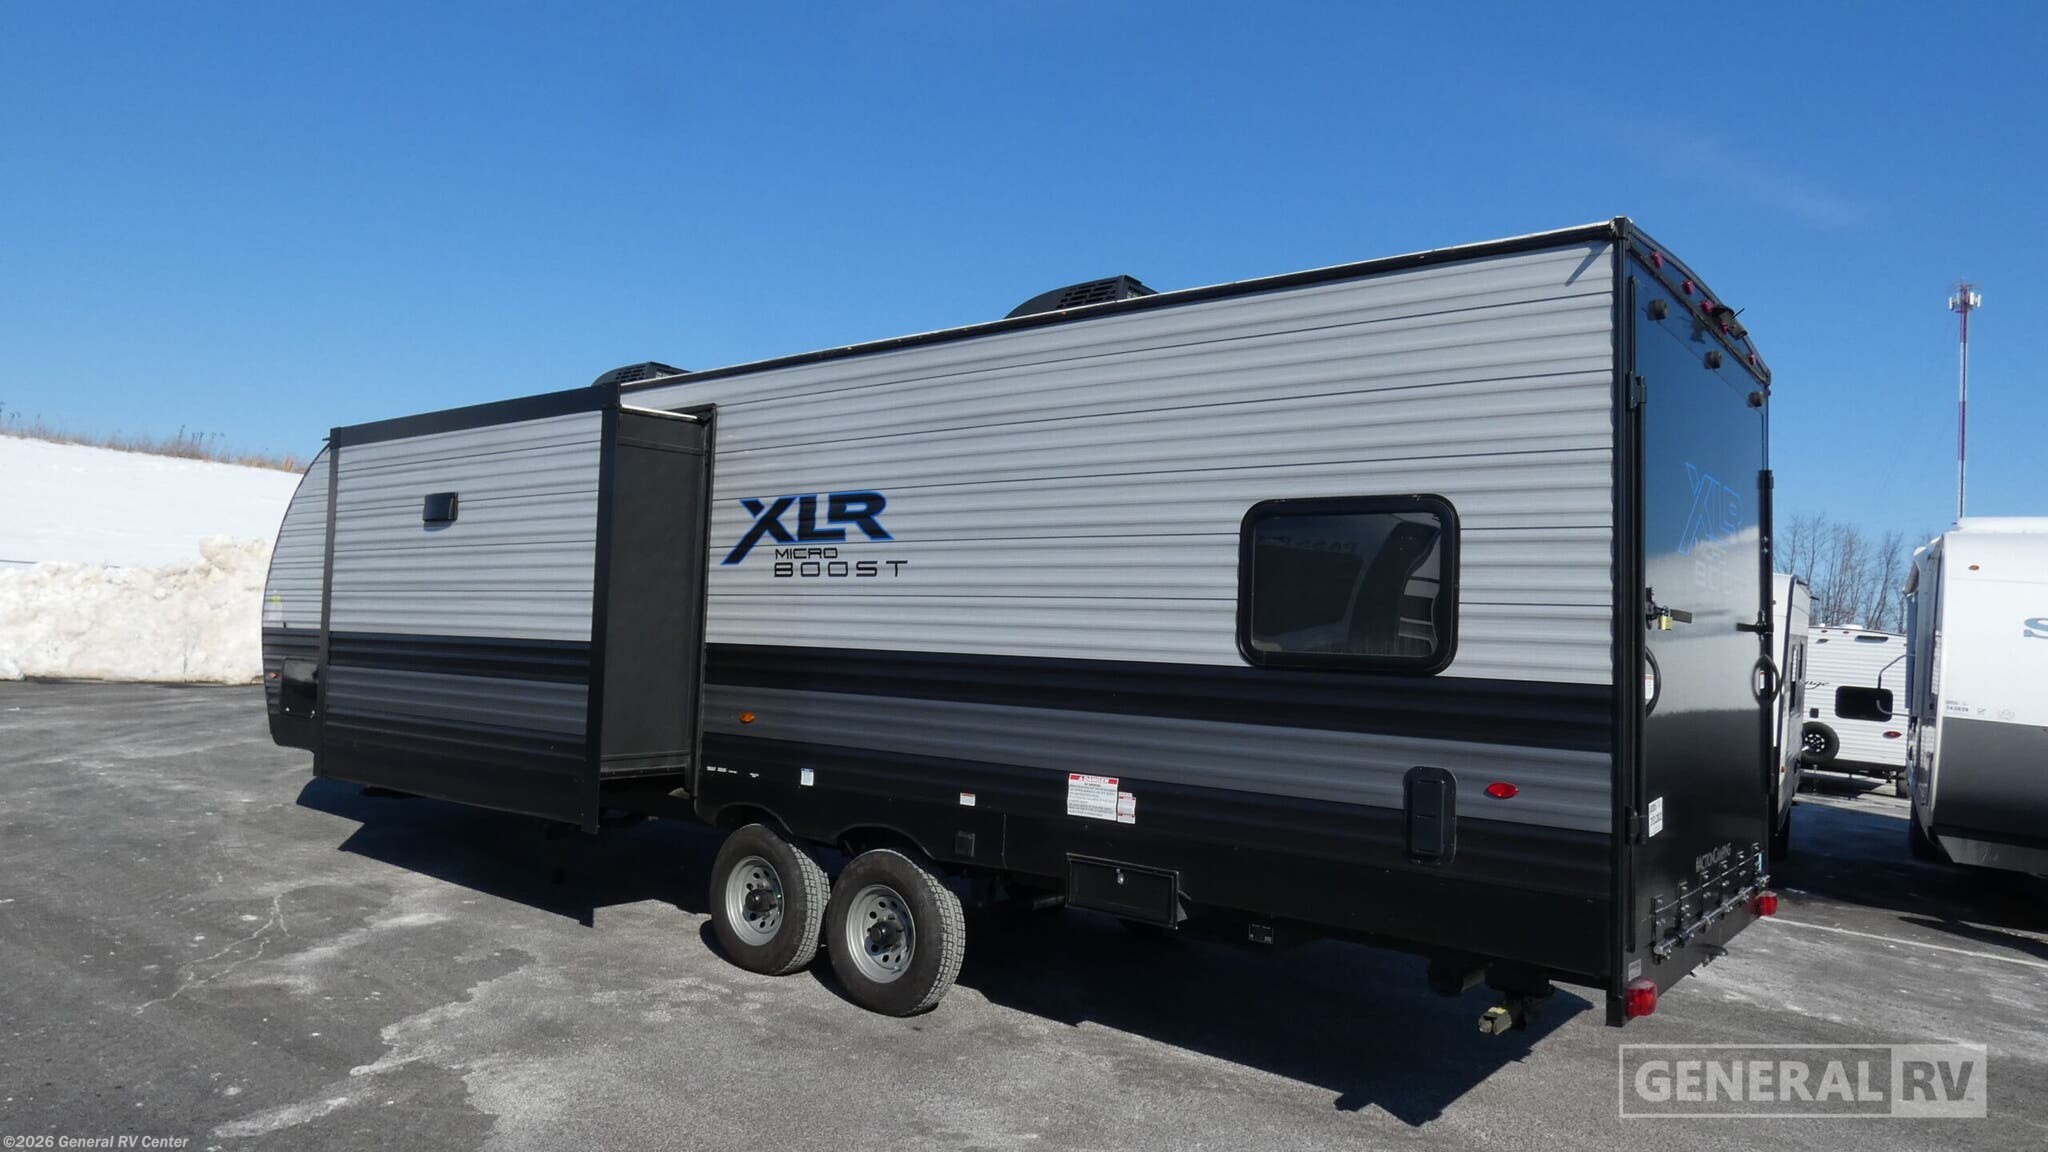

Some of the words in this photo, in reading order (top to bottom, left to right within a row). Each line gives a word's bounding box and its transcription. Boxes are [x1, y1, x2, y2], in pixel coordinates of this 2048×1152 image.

[720, 490, 895, 565] XLR
[775, 547, 838, 560] MICRO
[774, 560, 908, 578] BOOST
